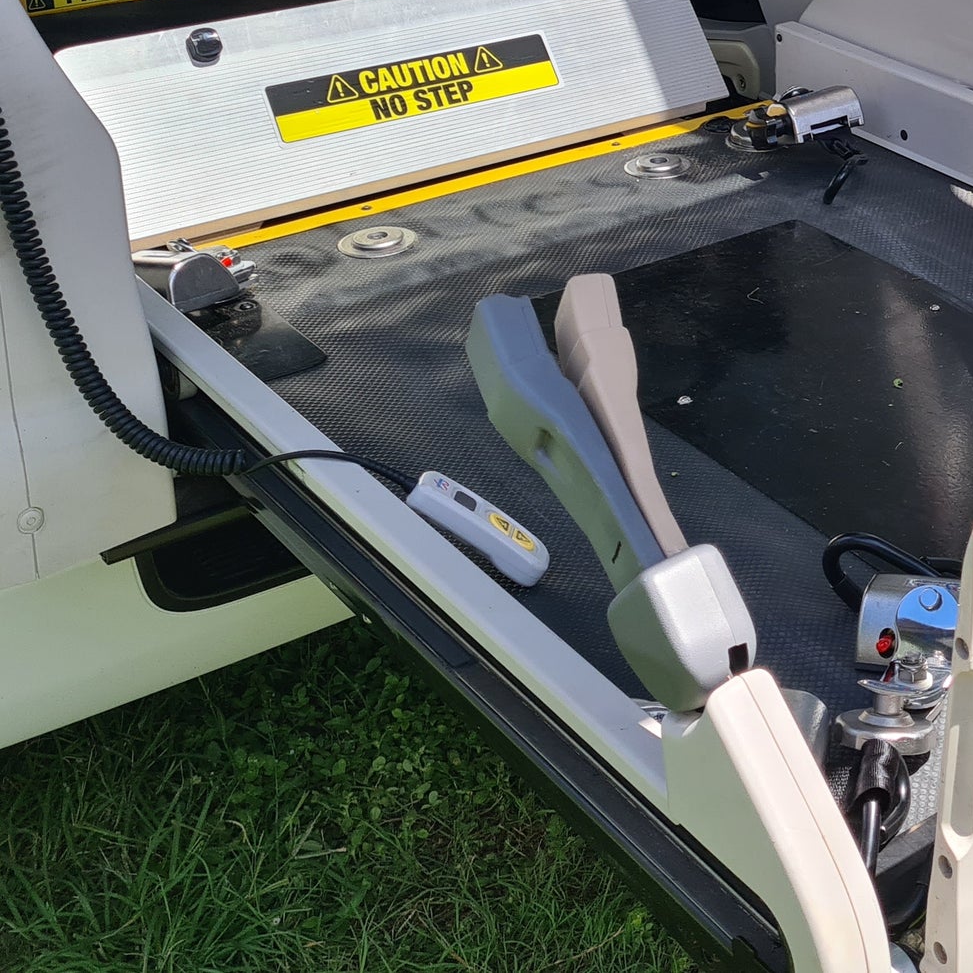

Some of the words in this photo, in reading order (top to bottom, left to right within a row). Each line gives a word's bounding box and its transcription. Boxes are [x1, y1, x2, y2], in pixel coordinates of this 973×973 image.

[358, 52, 470, 94] CAUTION
[369, 94, 408, 120] NO
[413, 80, 473, 112] STEP
